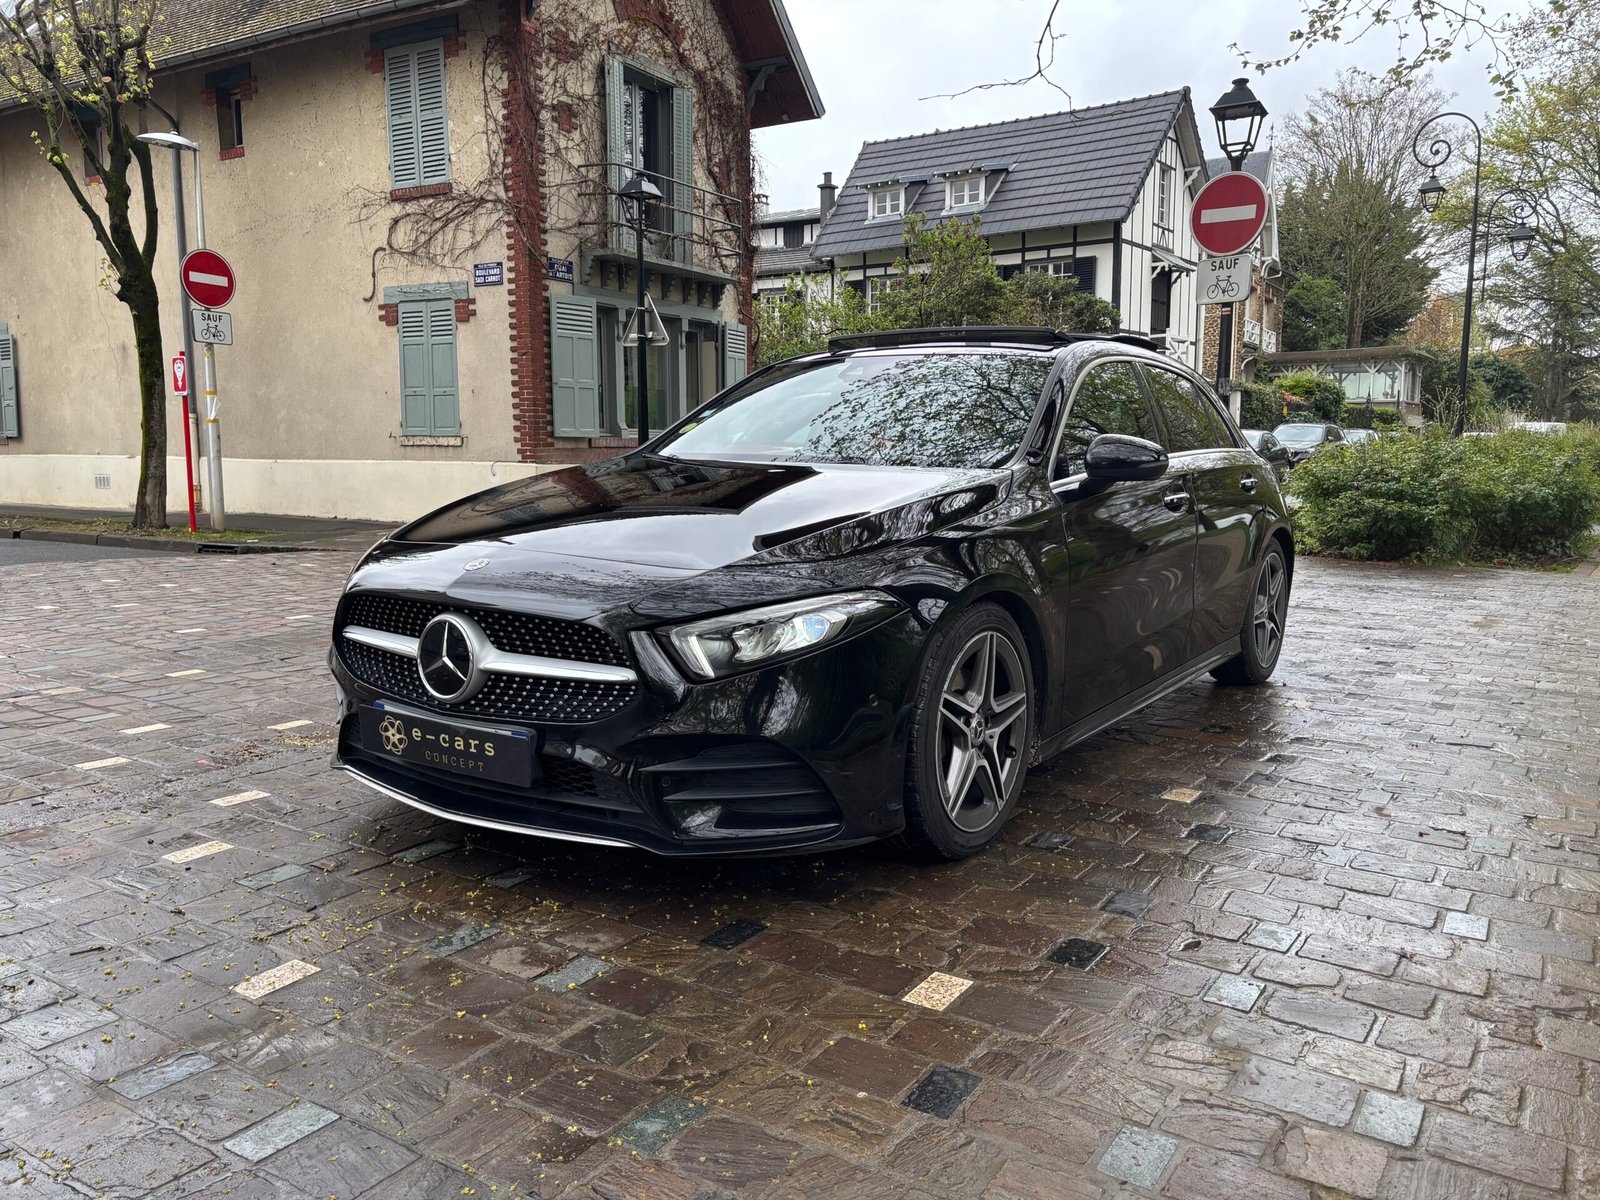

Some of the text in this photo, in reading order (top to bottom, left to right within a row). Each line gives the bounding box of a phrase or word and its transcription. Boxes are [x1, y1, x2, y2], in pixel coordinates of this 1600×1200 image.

[1210, 258, 1240, 272] SAUF
[475, 268, 500, 276] BOULEVARD
[485, 275, 501, 283] CARNOT
[201, 312, 223, 323] SAUF
[412, 728, 495, 756] e-cars
[425, 750, 484, 772] CONCEPT
